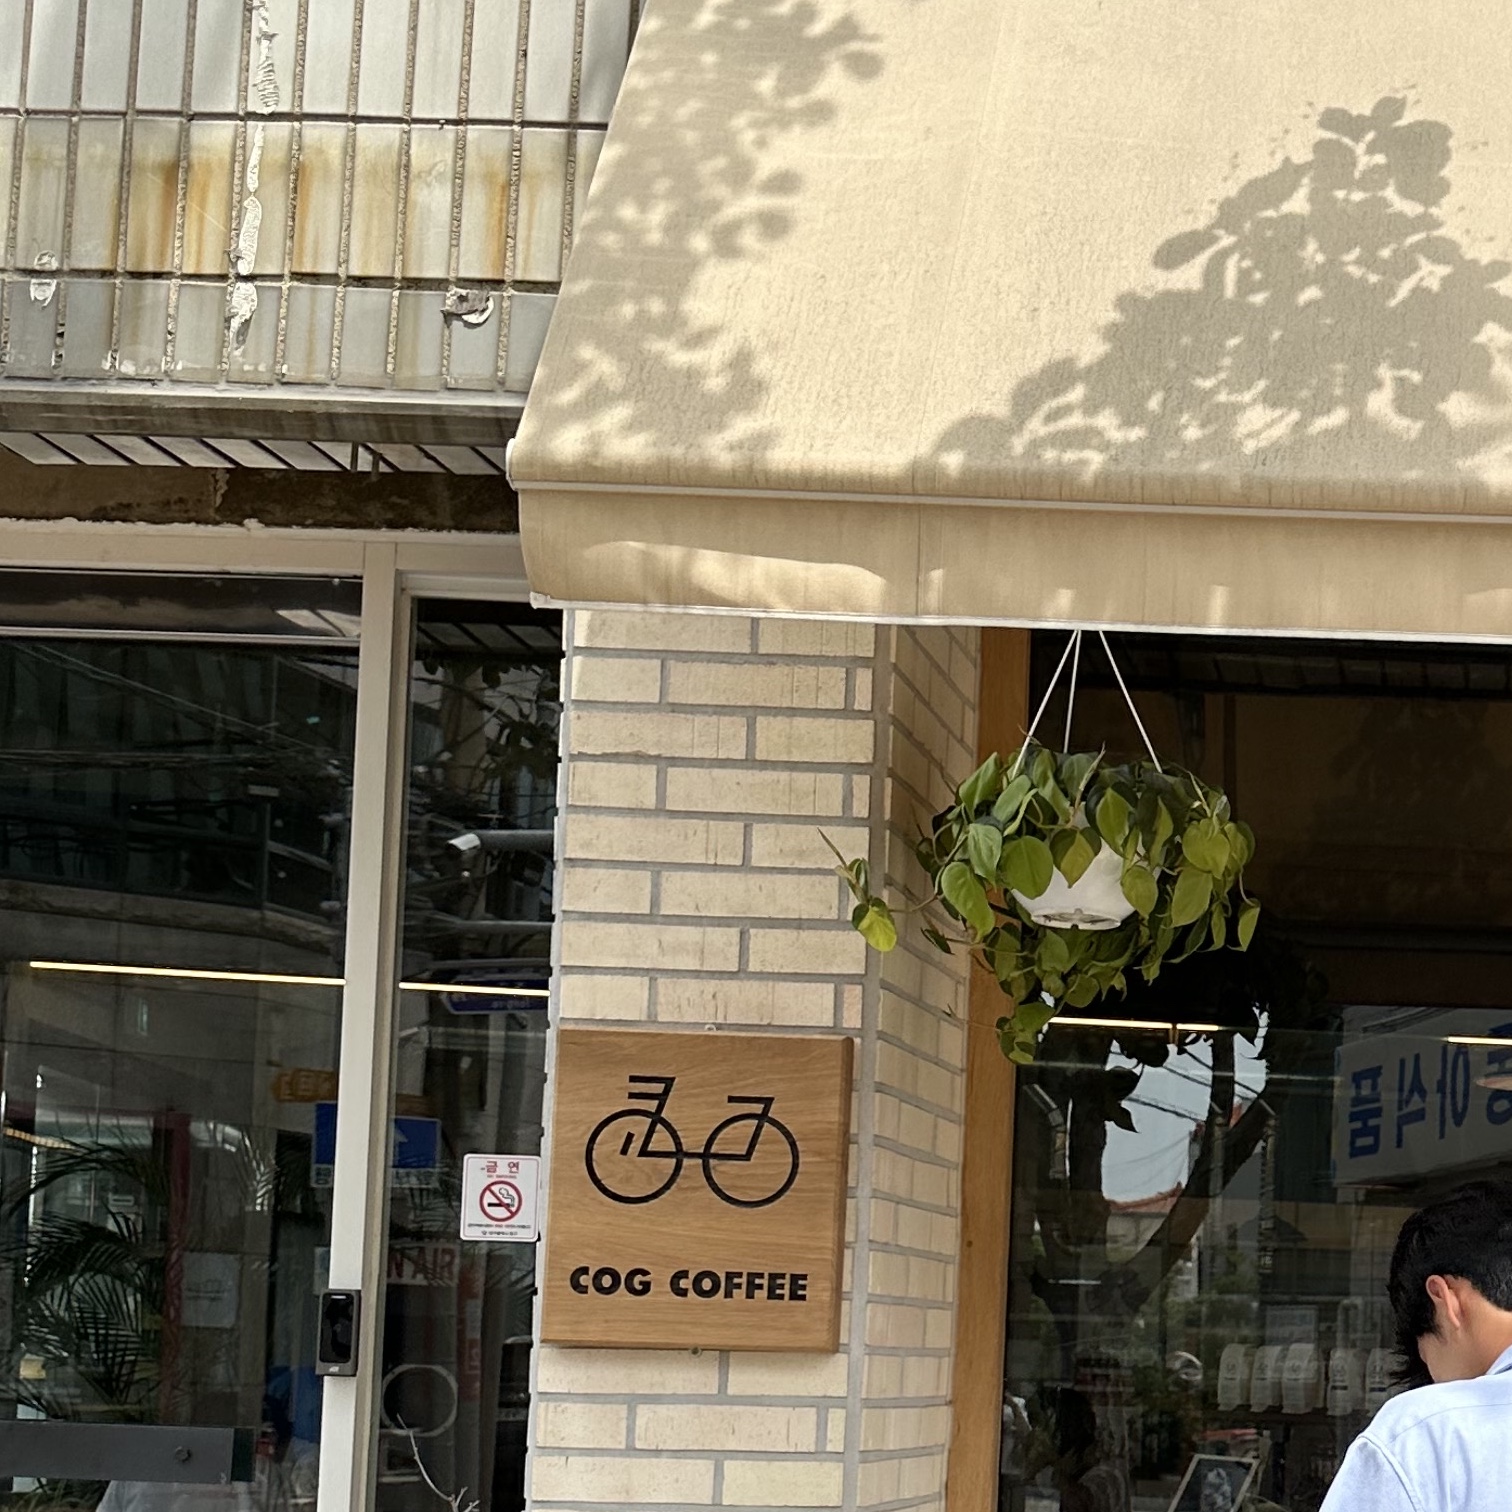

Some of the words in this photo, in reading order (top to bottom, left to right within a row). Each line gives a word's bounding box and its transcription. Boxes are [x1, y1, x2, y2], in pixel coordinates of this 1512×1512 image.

[485, 1160, 520, 1174] 금연
[411, 1246, 456, 1281] AIR
[568, 1265, 652, 1297] COG
[669, 1269, 809, 1301] COFFEE
